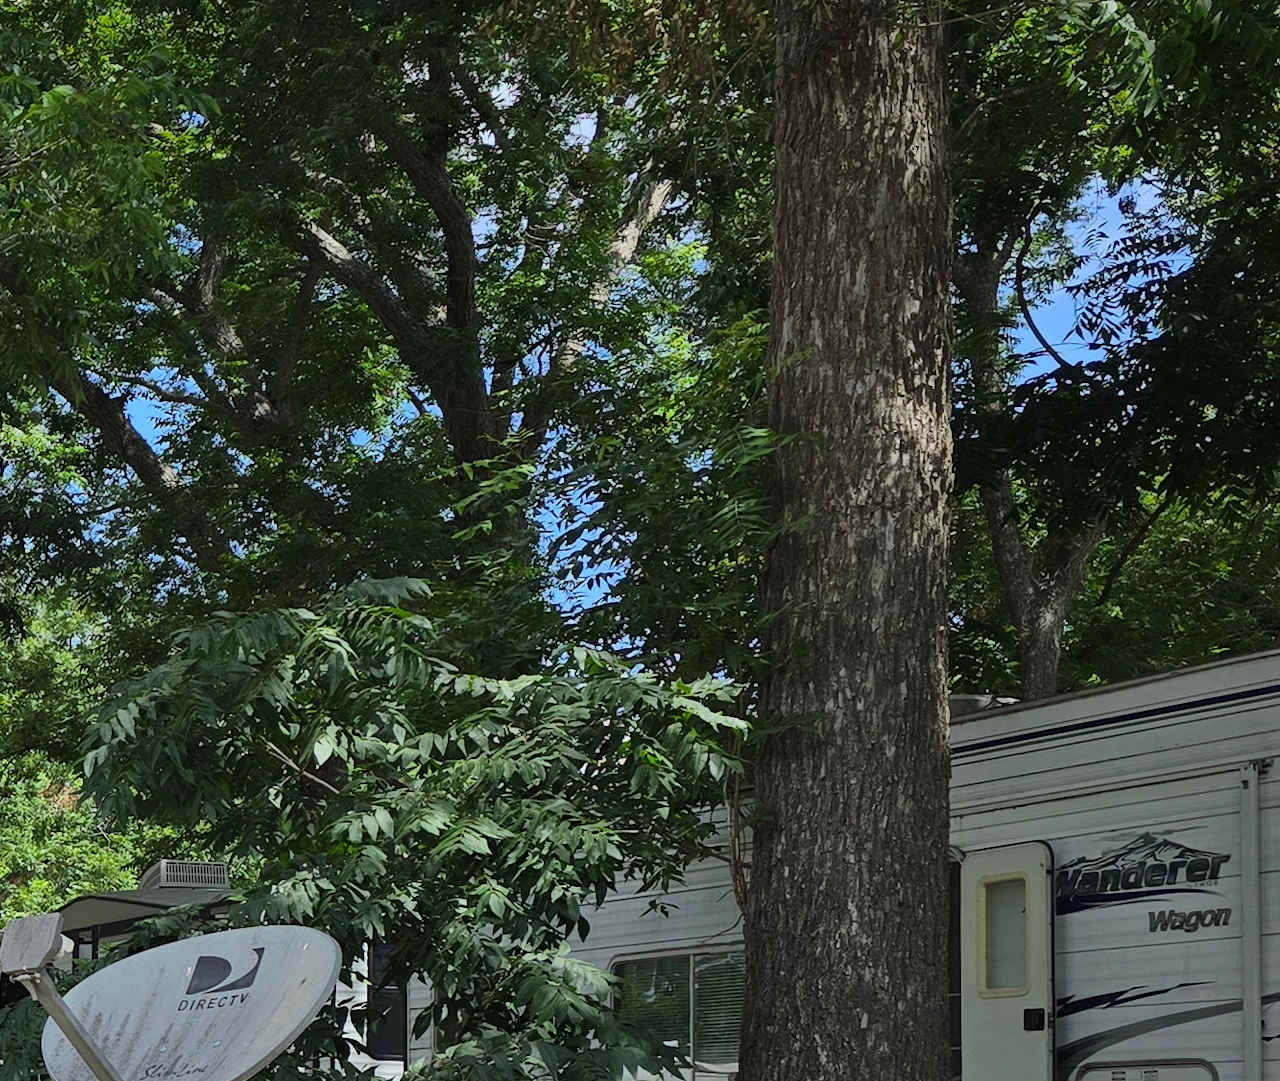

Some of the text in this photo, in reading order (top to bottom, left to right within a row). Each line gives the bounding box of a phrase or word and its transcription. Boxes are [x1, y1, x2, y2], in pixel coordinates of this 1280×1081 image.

[1056, 853, 1232, 899] Wanderer
[1147, 907, 1232, 933] Wagon
[177, 993, 249, 1012] DIRECTV
